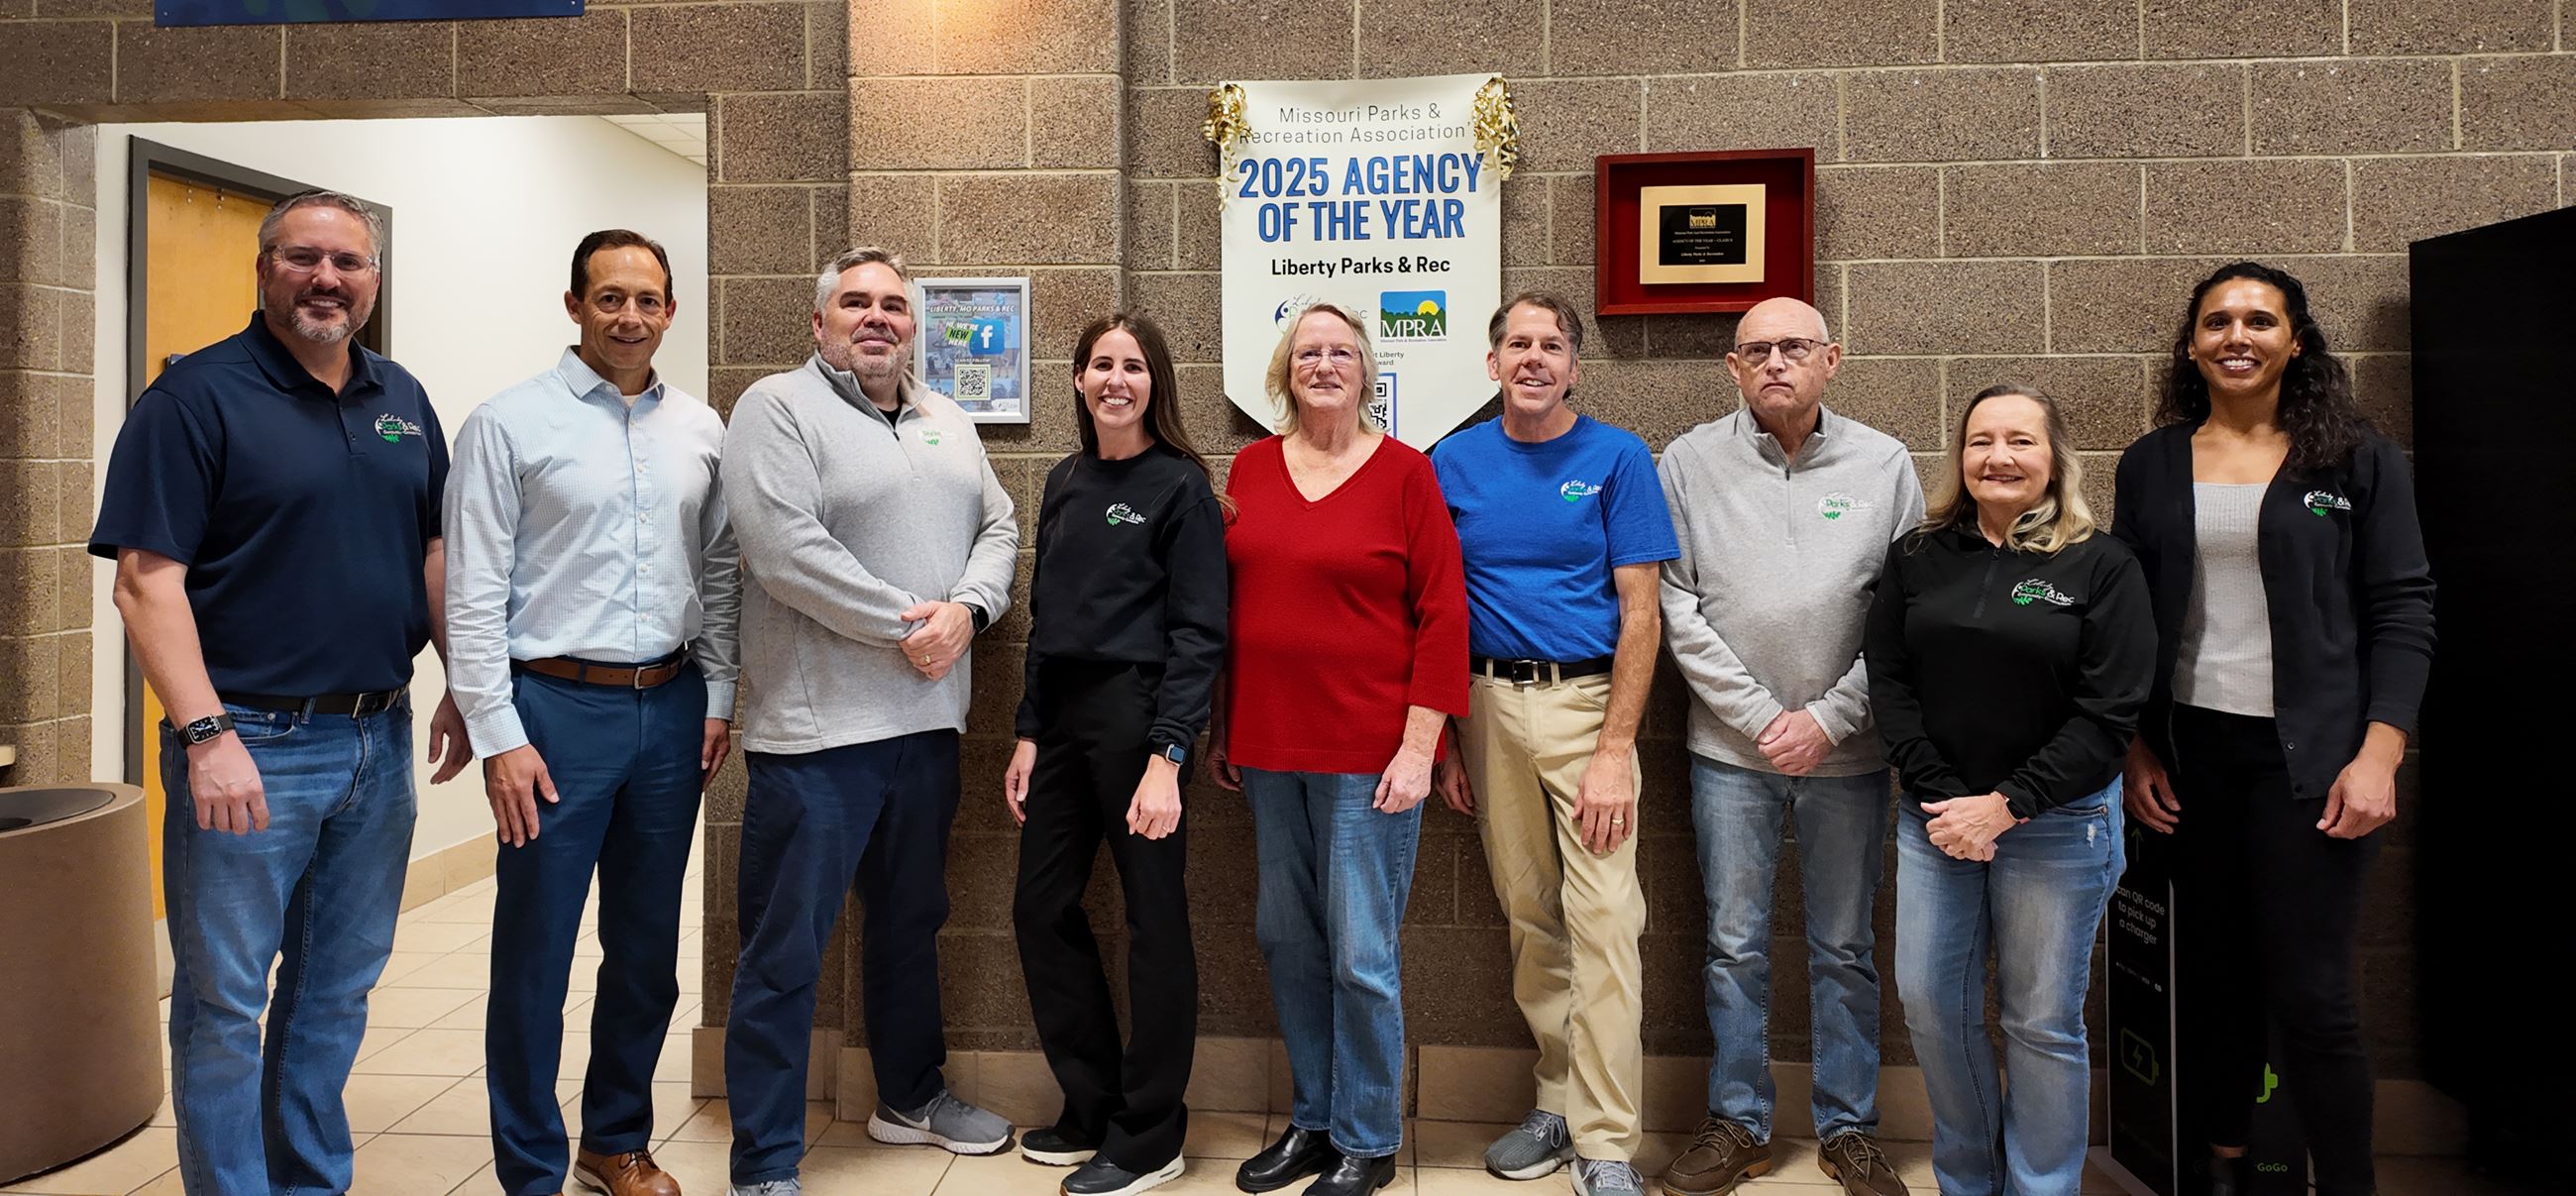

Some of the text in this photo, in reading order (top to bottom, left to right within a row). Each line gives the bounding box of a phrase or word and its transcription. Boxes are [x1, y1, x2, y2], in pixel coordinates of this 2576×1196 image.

[1279, 102, 1442, 124] Missouri Parks &
[1349, 121, 1472, 143] Association'
[1238, 153, 1484, 198] 2025 AGENCY
[1258, 198, 1465, 243] OF THE YEAR
[1271, 256, 1450, 278] Liberty Parks & Rec
[948, 329, 969, 340] NEW
[1380, 318, 1447, 338] MPRA
[2021, 585, 2046, 597] Parks
[2047, 589, 2056, 598] &
[2056, 593, 2075, 603] Rec
[2116, 886, 2166, 916] can QR code
[2118, 900, 2157, 930] to pick up
[2119, 919, 2158, 945] a charger
[2257, 1162, 2288, 1172] GoGo
